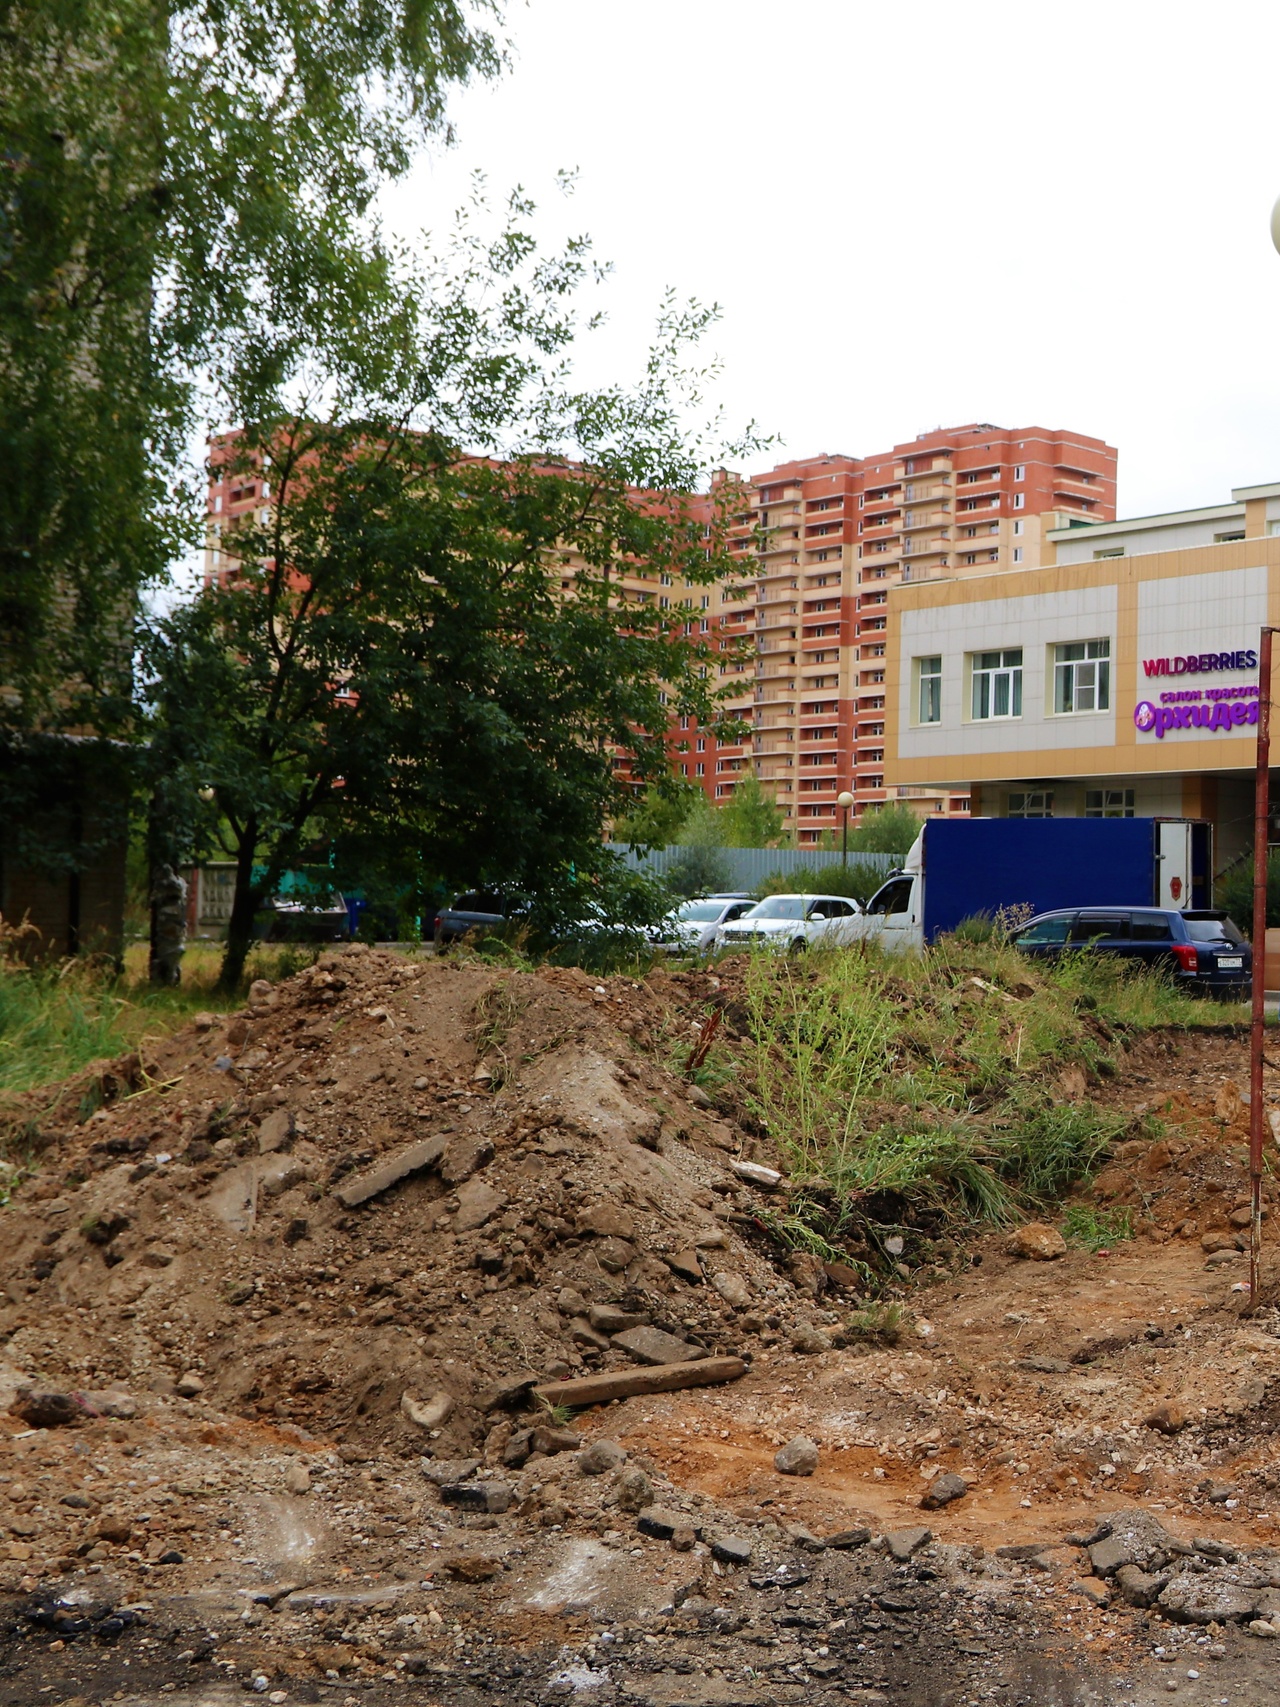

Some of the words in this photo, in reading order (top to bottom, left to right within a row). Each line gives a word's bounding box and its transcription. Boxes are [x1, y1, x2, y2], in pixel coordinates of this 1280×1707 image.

[1142, 650, 1257, 677] WILDBERRIES
[1159, 690, 1203, 703] салон
[1133, 700, 1260, 739] Орхидея
